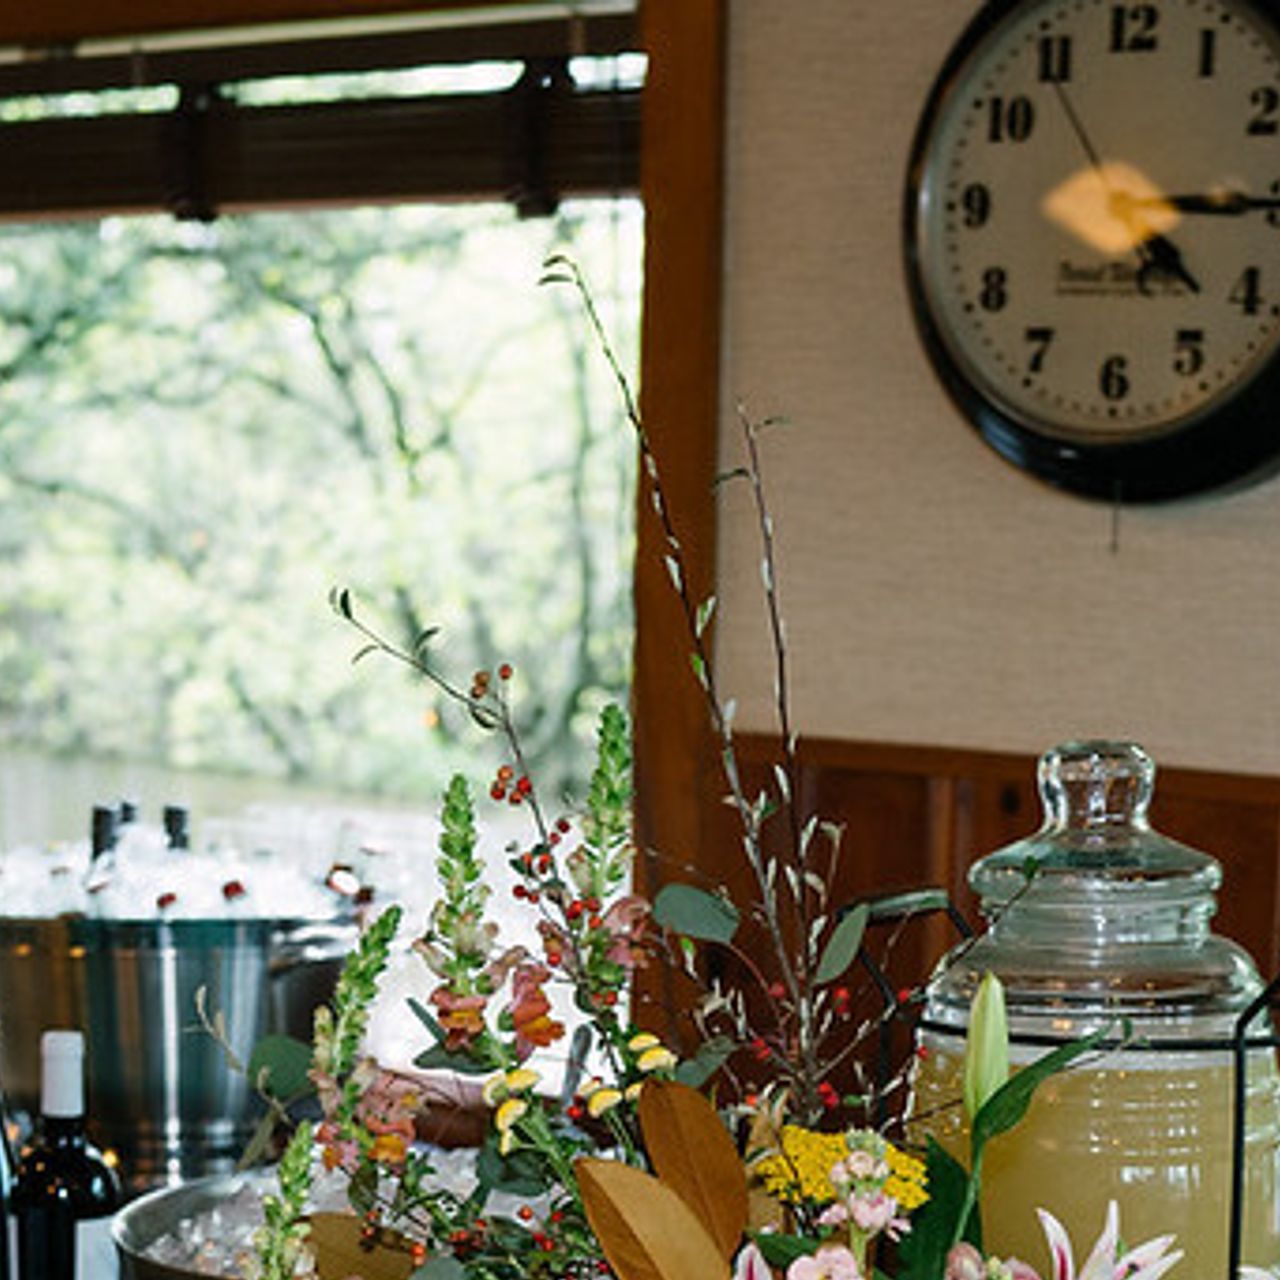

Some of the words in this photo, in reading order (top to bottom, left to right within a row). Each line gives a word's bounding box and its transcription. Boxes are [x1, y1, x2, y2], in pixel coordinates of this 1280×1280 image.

[1109, 4, 1159, 52] 12
[1037, 36, 1073, 83] 11
[1198, 27, 1216, 79] 1
[986, 95, 1035, 143] 10
[1245, 85, 1280, 138] 2
[961, 183, 991, 229] 9
[978, 266, 1009, 313] 8
[1228, 265, 1262, 317] 4
[1025, 328, 1055, 373] 7
[1173, 328, 1205, 376] 5
[1098, 355, 1131, 402] 6
